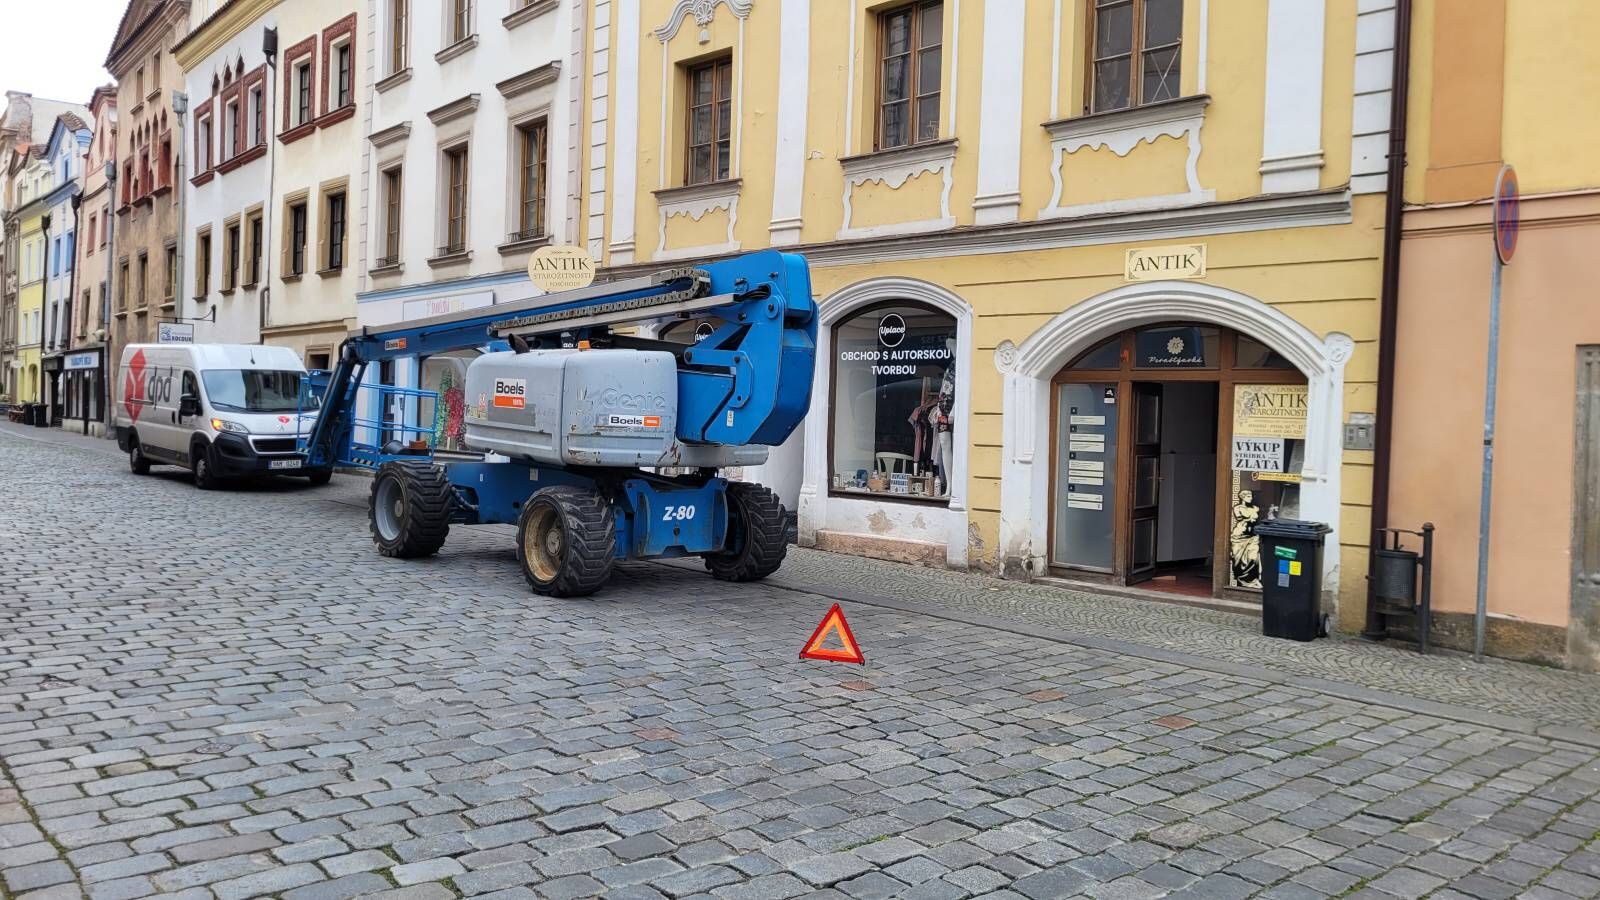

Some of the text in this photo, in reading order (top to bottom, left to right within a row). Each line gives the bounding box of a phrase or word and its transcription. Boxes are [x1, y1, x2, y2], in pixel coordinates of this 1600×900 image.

[533, 257, 591, 271] ANTIK
[1134, 253, 1196, 271] ANTIK
[879, 325, 906, 336] Uplace
[841, 349, 951, 361] OBCHOD S AUTORSKOU
[871, 365, 917, 376] TVORBOU
[148, 366, 173, 407] dpd
[495, 381, 525, 395] Boels
[1252, 393, 1307, 407] ANTIK
[610, 416, 643, 425] Boels
[1236, 439, 1280, 452] VÝKUP
[1235, 459, 1280, 470] ZLATA
[662, 505, 696, 521] Z-80
